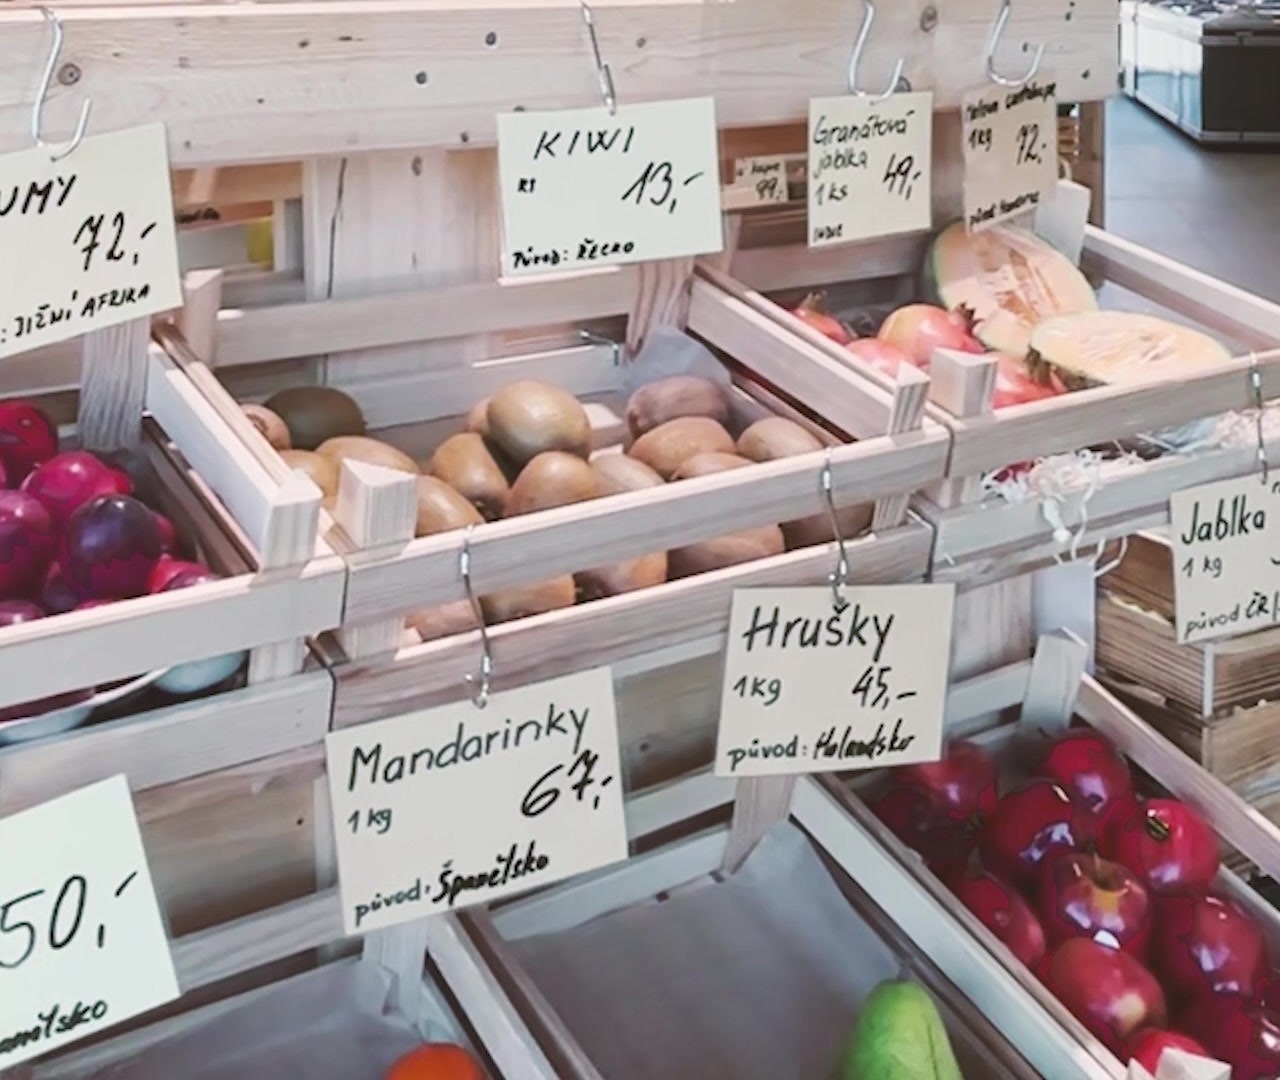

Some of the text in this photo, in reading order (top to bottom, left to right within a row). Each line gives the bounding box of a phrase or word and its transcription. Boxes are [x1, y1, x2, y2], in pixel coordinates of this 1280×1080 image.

[532, 125, 636, 160] KIWI
[812, 108, 917, 147] Granátová
[1181, 493, 1267, 546] Jablka
[741, 602, 896, 664] Hrušky
[348, 702, 591, 793] Mandarinky
